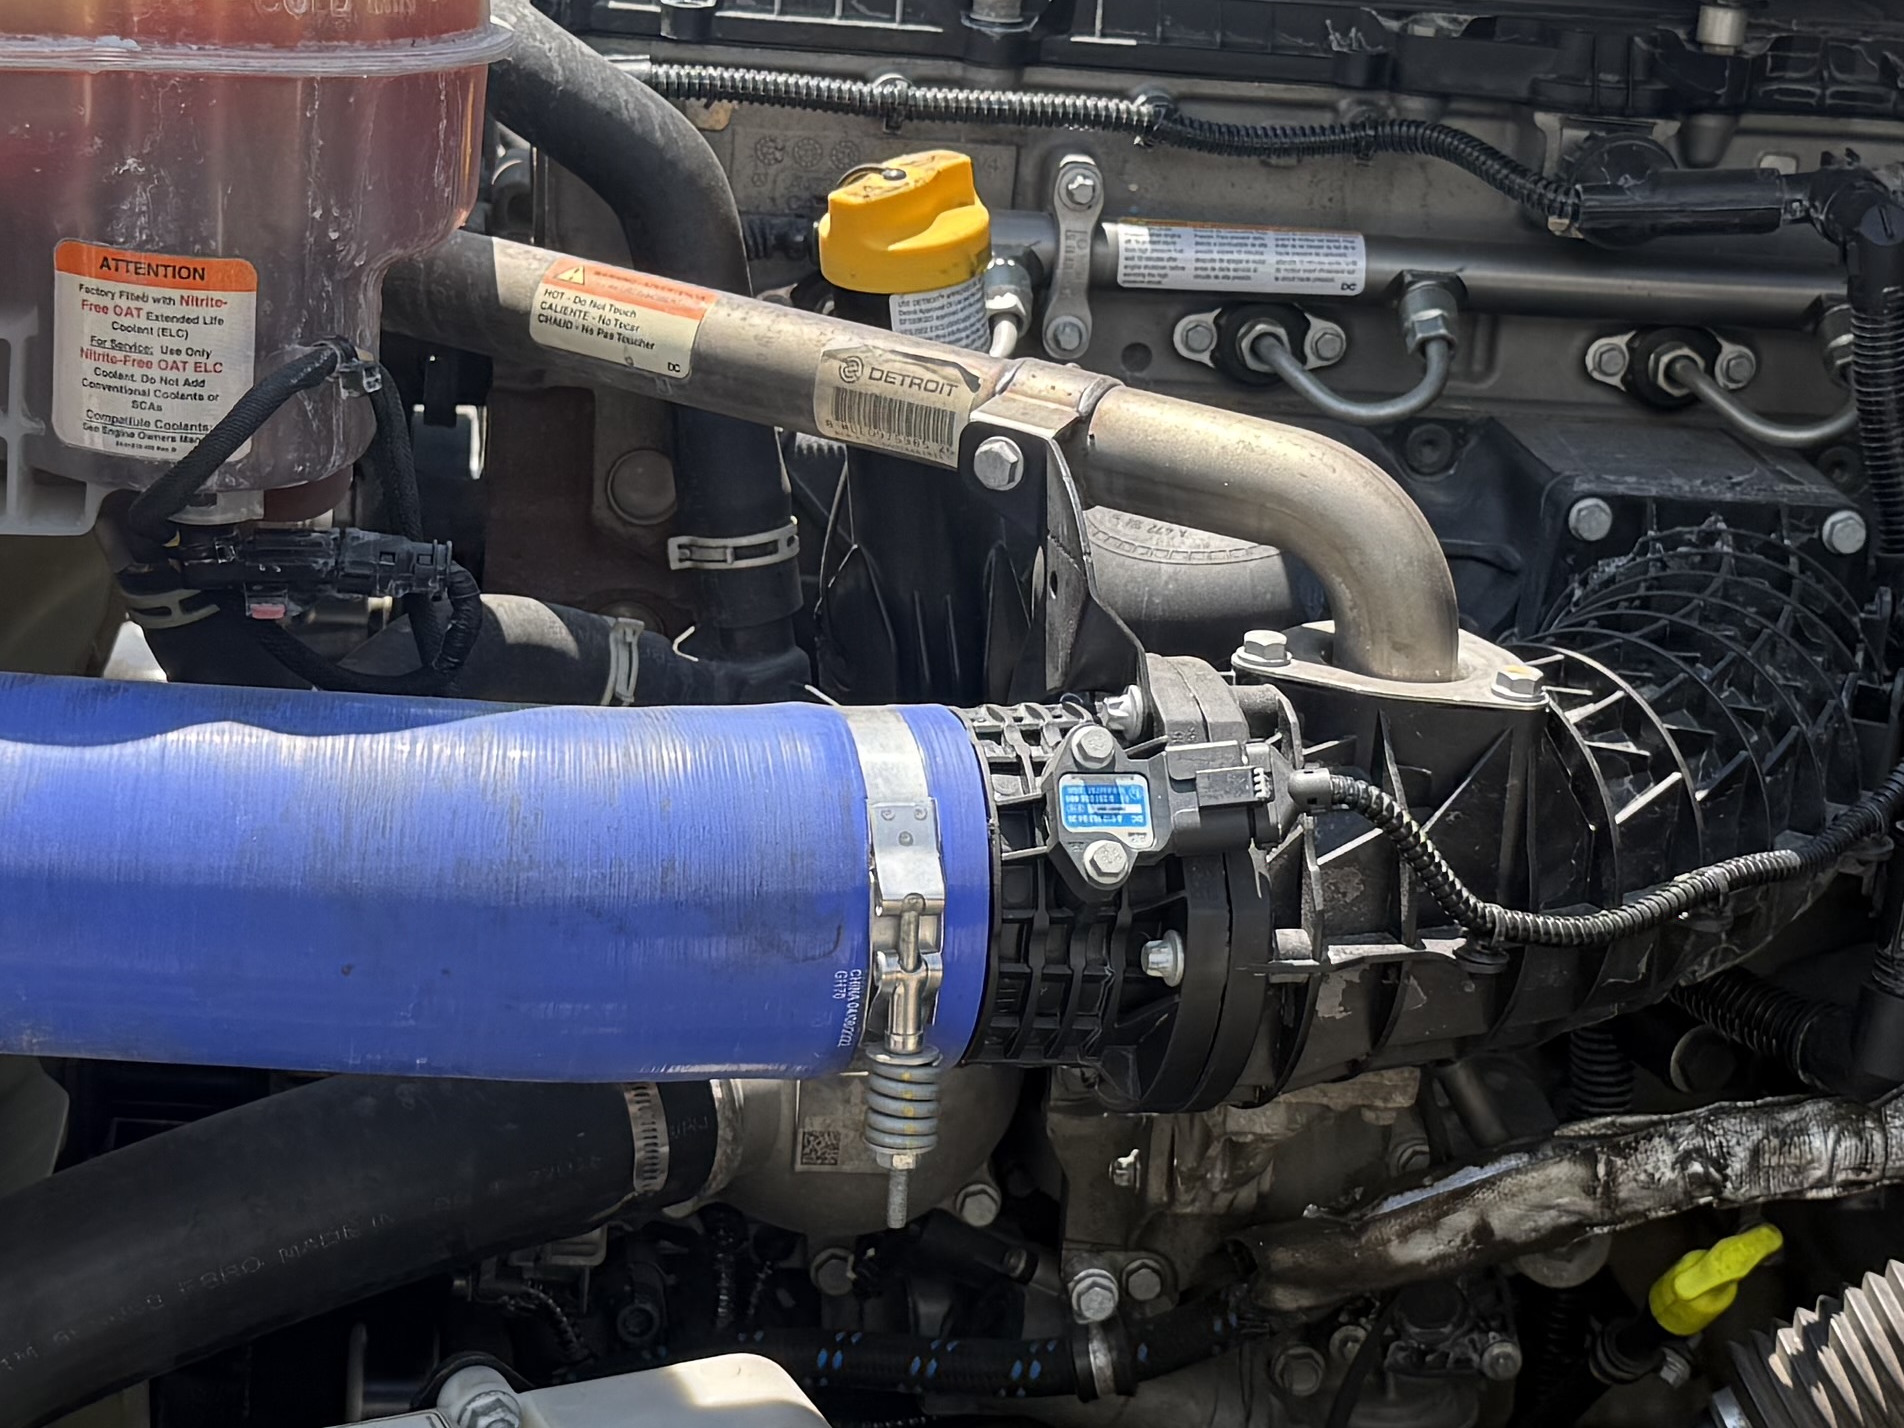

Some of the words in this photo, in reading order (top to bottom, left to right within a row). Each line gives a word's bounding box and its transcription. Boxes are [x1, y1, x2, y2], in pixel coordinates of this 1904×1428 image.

[99, 256, 206, 281] ATTENTION
[79, 283, 116, 301] Factory
[119, 290, 149, 303] Filled
[151, 295, 176, 306] with
[179, 294, 228, 308] Nitrite-
[1340, 282, 1357, 291] DC
[81, 299, 109, 314] Free
[113, 303, 144, 319] OAT
[146, 311, 199, 325] Extended
[203, 315, 224, 326] Life
[544, 289, 564, 302] HOT
[573, 296, 585, 307] Do
[589, 299, 606, 312] Not
[608, 303, 637, 317] Touch
[540, 301, 589, 322] CALIENTE
[598, 315, 611, 326] No
[614, 318, 640, 332] Tocar
[112, 321, 154, 336] Coolant
[156, 326, 189, 341] (ELC)
[538, 314, 573, 330] CHAUD
[597, 329, 614, 340] Pas
[617, 332, 656, 350] Toucher
[90, 335, 108, 348] For
[110, 338, 154, 355] Service:
[160, 346, 182, 357] Use
[186, 347, 213, 360] Only
[80, 347, 154, 369] Nitrite-Free
[157, 359, 189, 373] OAT
[194, 362, 224, 374] ELC
[667, 362, 681, 373] DC
[82, 377, 151, 398] Conventional
[153, 389, 204, 401] Coolants
[207, 393, 220, 402] or
[141, 374, 156, 384] Do
[160, 375, 179, 386] Not
[183, 378, 206, 388] Add
[868, 367, 959, 397] DETROIT
[131, 400, 163, 411] SCAs
[86, 409, 151, 428] Compatible
[83, 423, 100, 433] See
[102, 424, 134, 439] Engine
[138, 431, 177, 443] Owners
[847, 969, 862, 1001] CHINA
